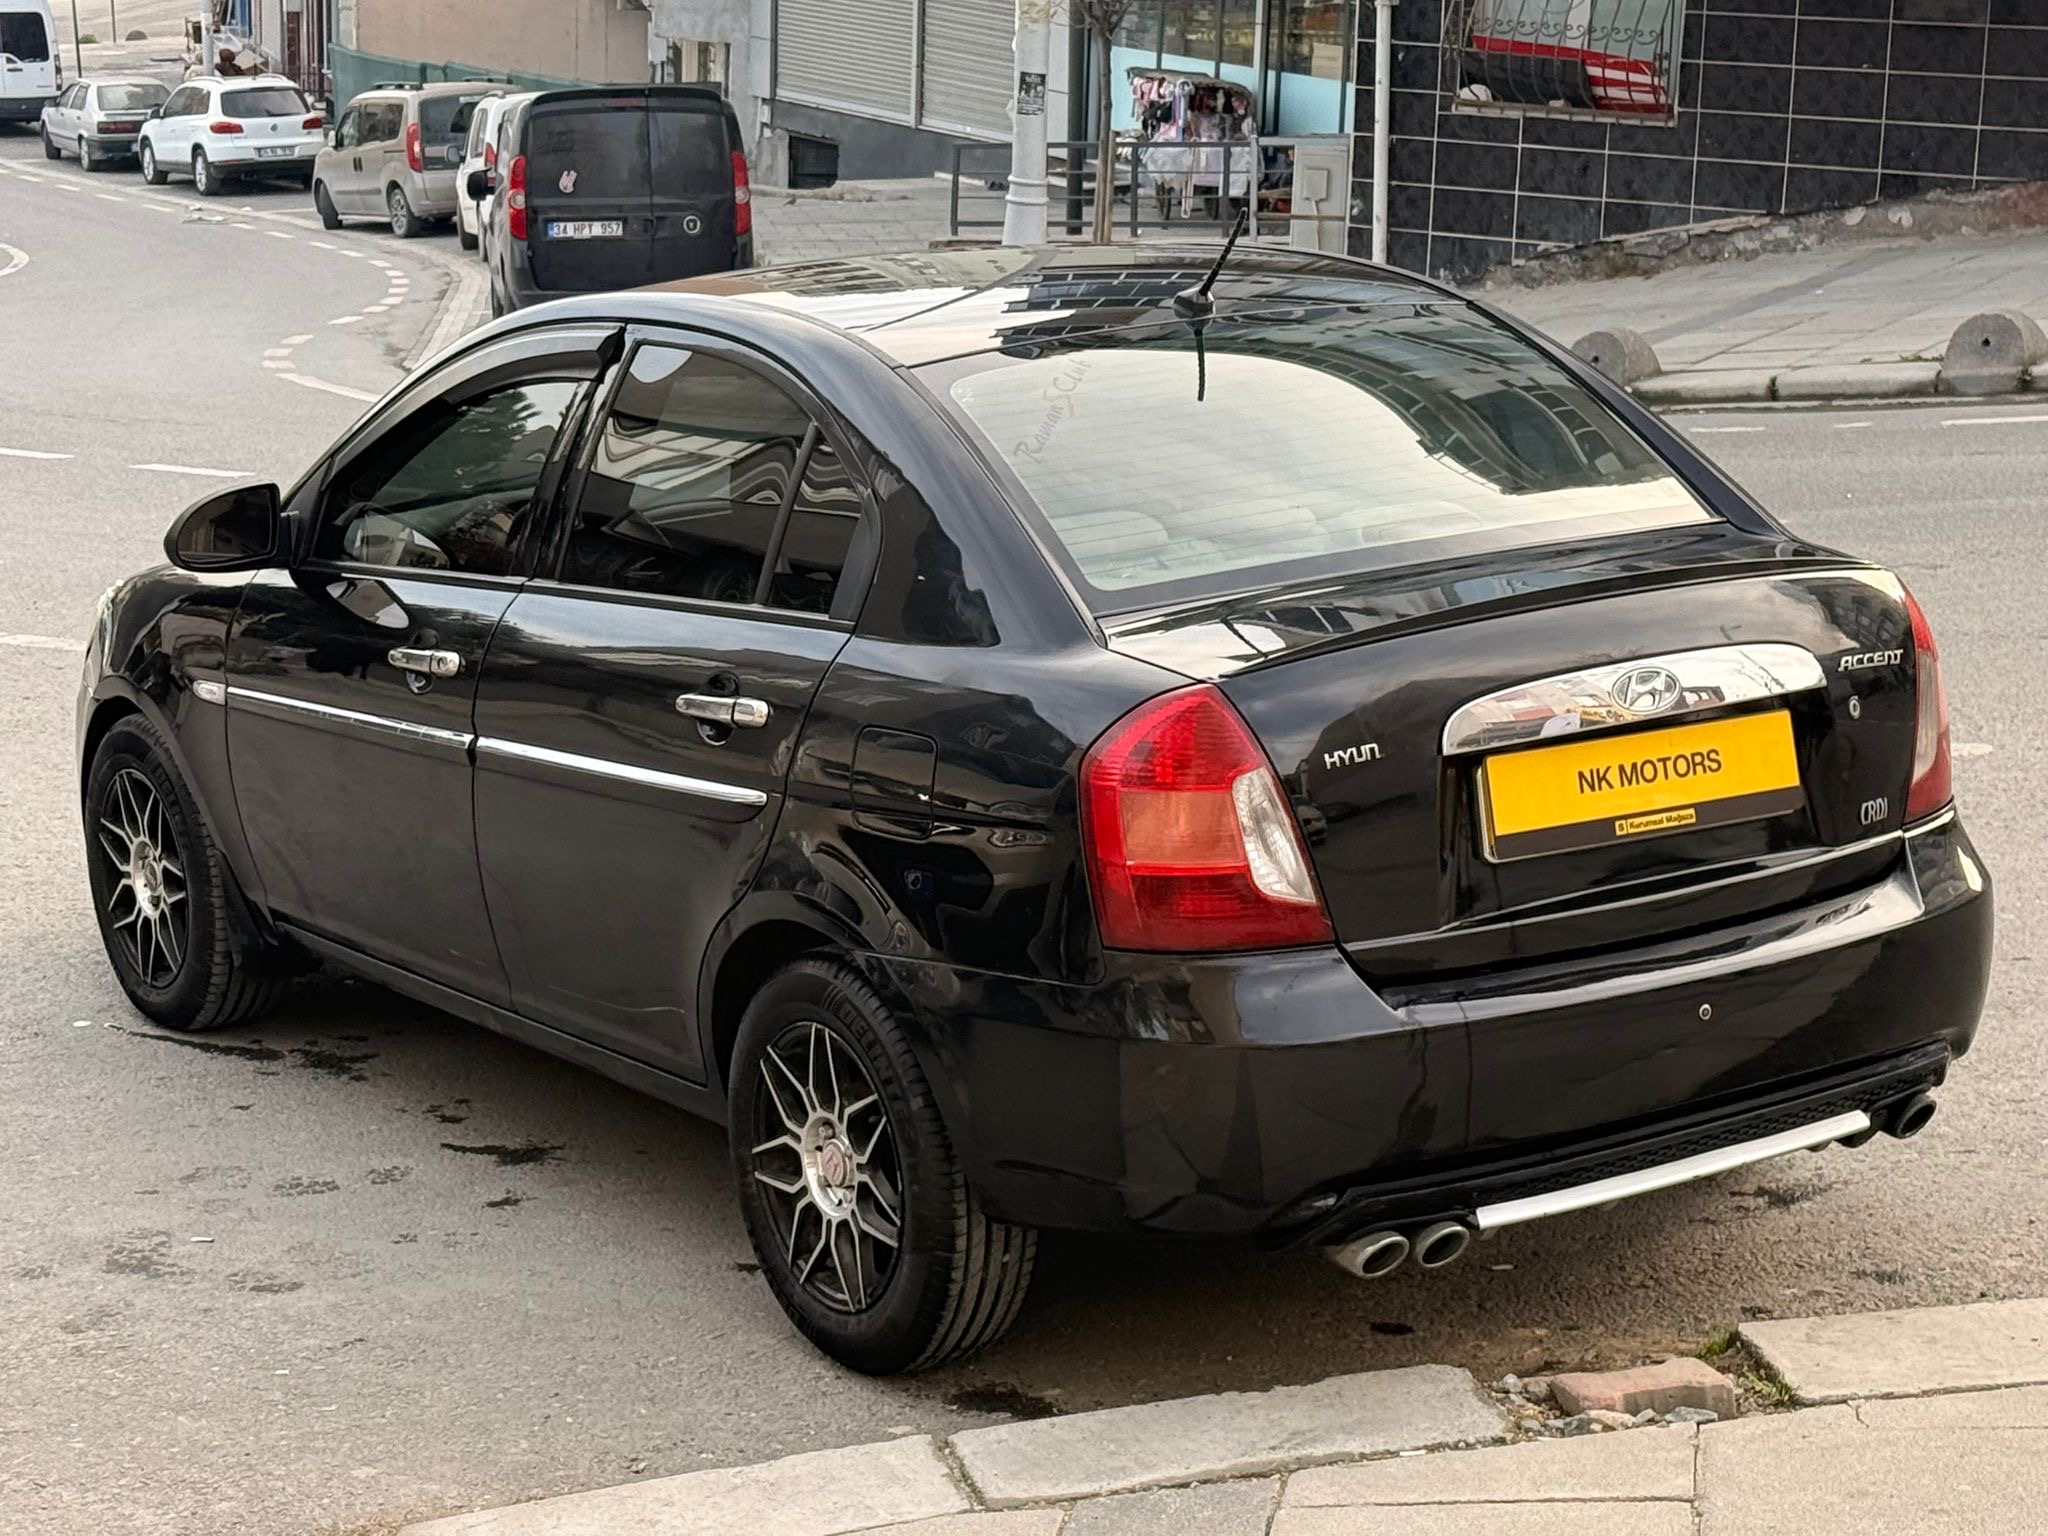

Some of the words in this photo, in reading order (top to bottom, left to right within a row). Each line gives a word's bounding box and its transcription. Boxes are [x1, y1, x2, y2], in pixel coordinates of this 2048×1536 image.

[554, 224, 568, 236] 34
[1838, 648, 1904, 672] ACCENT
[1323, 742, 1381, 770] HYUN
[1577, 765, 1614, 794] NK
[1618, 749, 1722, 788] MOTORS
[1860, 796, 1888, 826] CRDI
